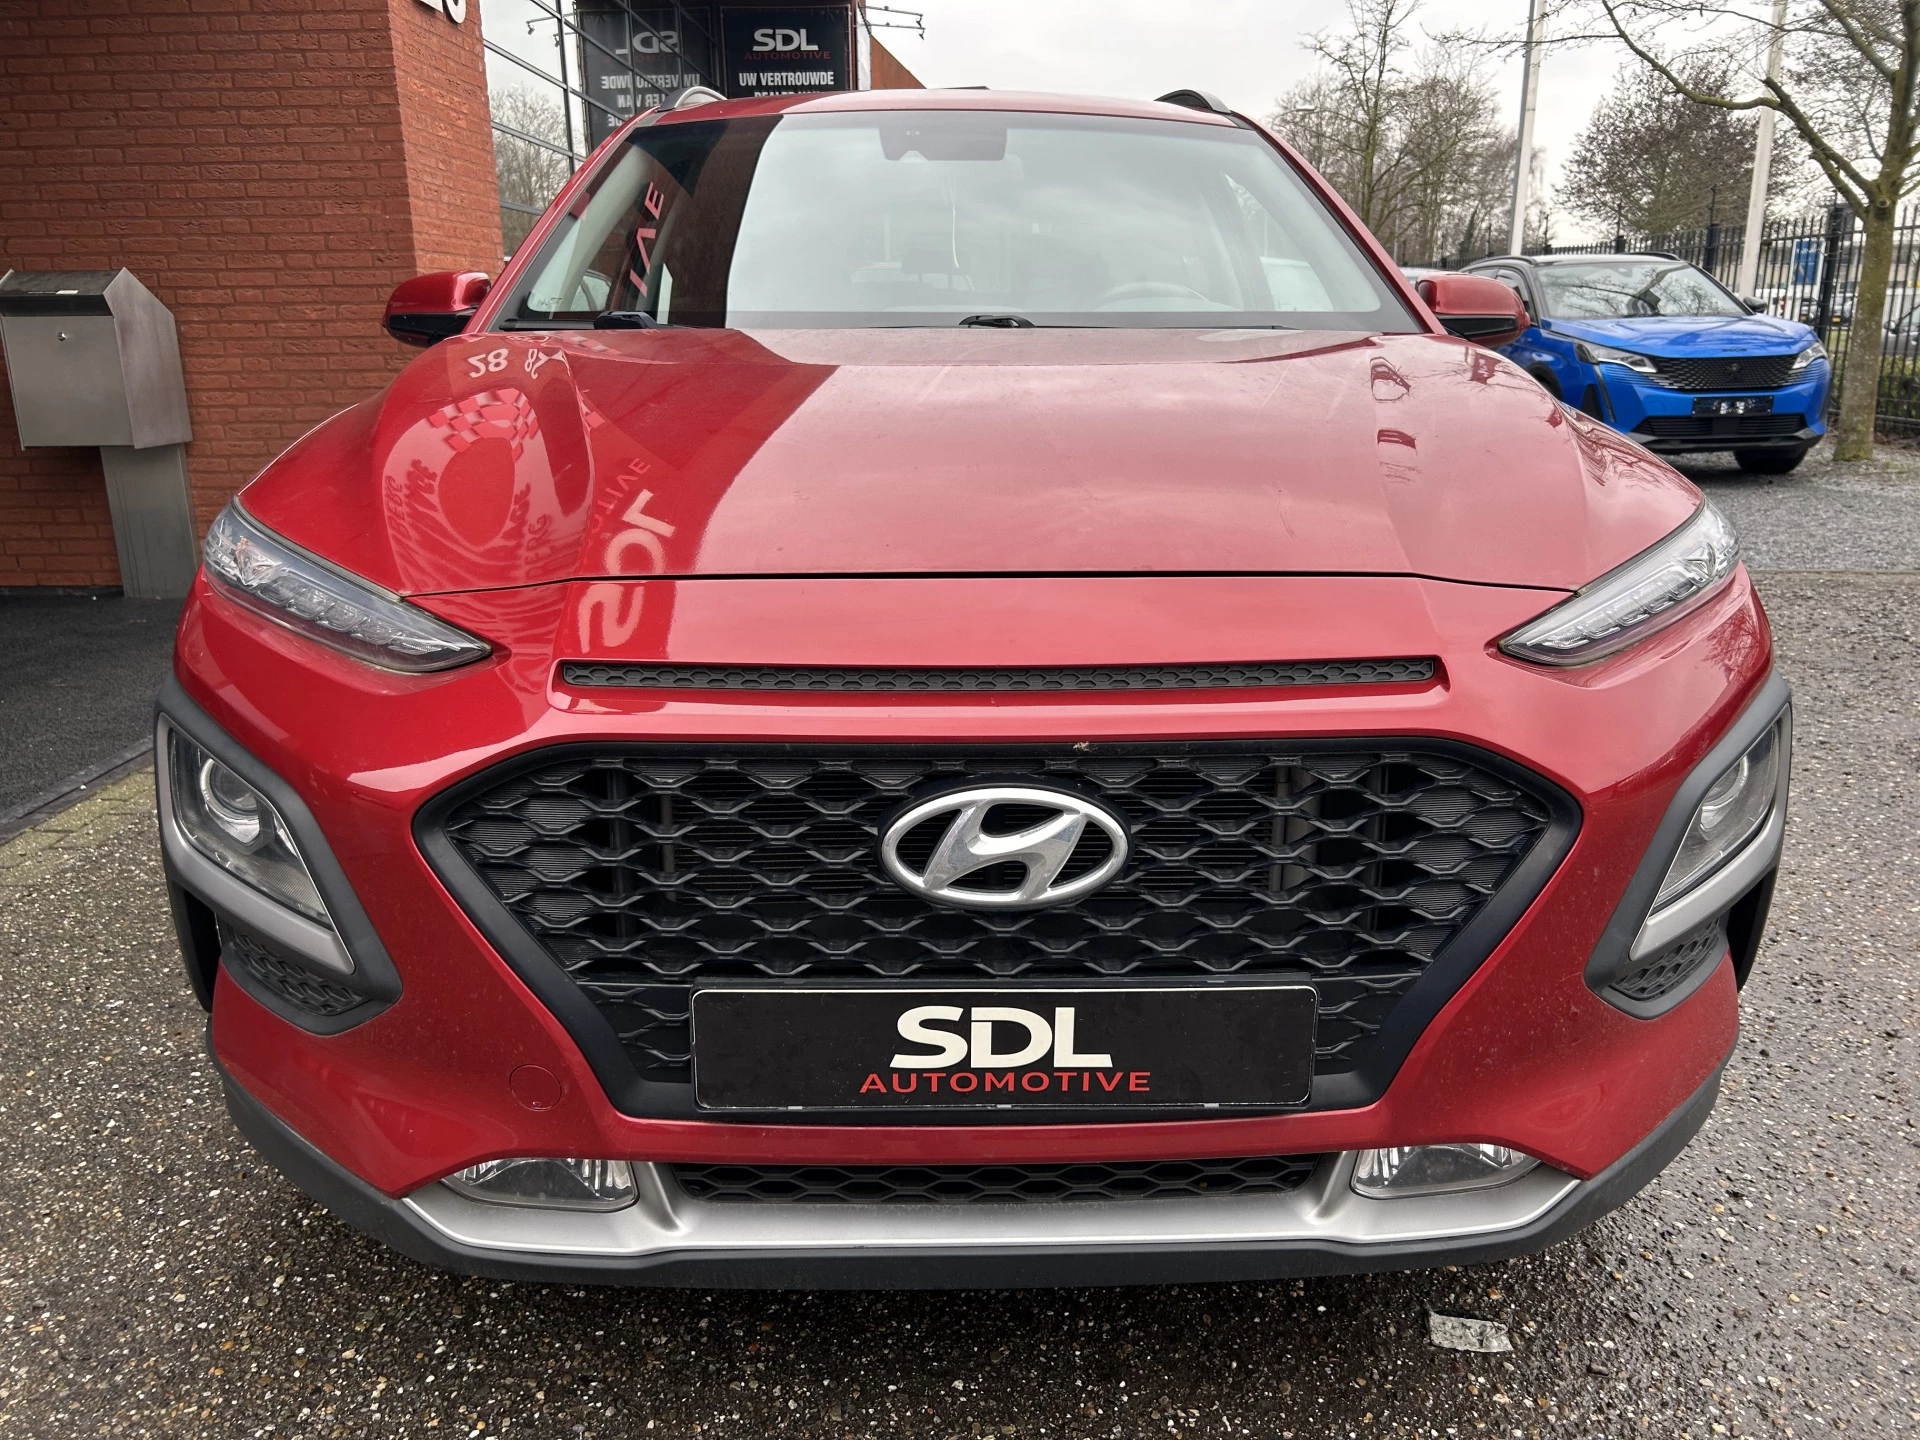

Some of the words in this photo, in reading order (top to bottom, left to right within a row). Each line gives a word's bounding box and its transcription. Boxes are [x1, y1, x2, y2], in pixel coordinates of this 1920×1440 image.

[752, 29, 819, 52] SDL
[744, 51, 831, 60] AUTOMOTIVE
[739, 72, 757, 86] UW
[760, 71, 834, 86] VERTROUWDE
[889, 1005, 1113, 1069] SDL
[859, 1071, 1151, 1093] AUTOMOTIVE
